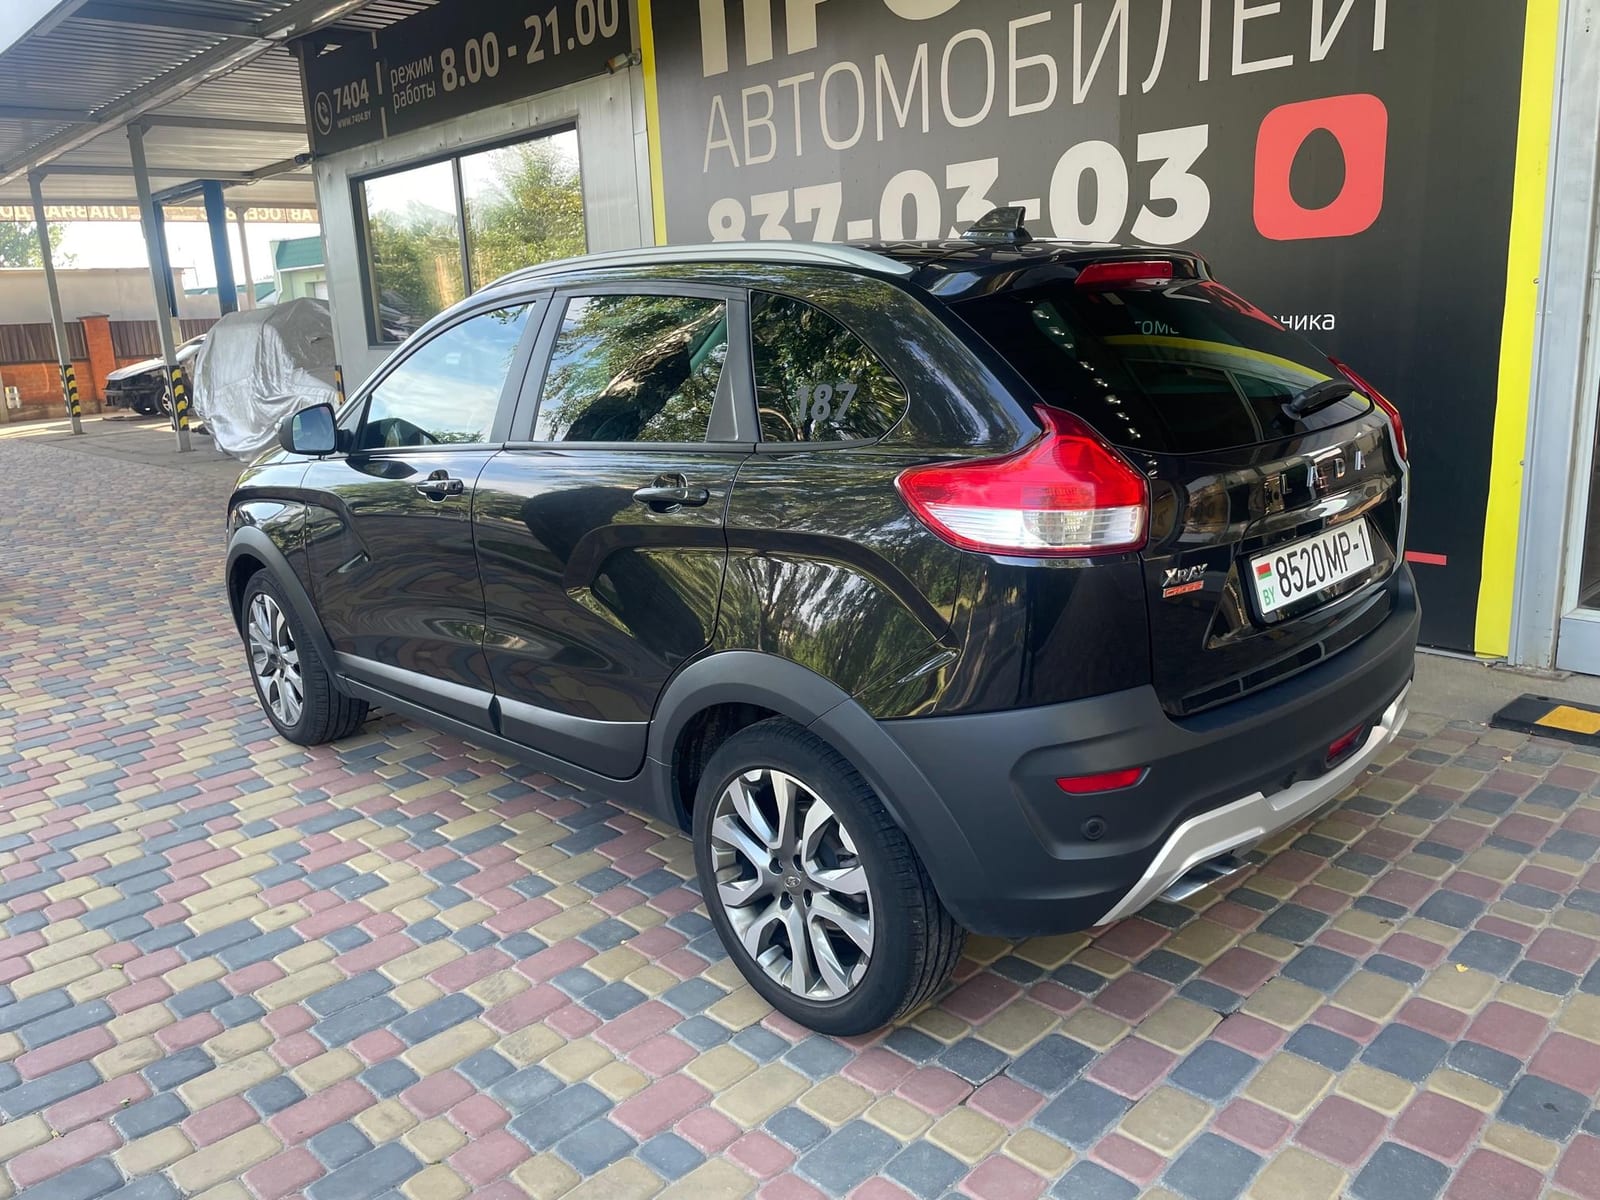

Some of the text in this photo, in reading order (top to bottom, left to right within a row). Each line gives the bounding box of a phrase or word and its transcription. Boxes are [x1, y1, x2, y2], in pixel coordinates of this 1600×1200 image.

[440, 32, 499, 92] 8.00
[523, 0, 620, 65] 21.00
[390, 55, 434, 92] режим
[333, 78, 369, 114] 7404
[393, 81, 436, 114] работы
[707, 124, 1211, 245] 837-03-03
[1273, 313, 1335, 331] чика
[796, 383, 858, 422] 187
[1281, 450, 1367, 495] LADA
[1275, 524, 1370, 598] 8520MP-1
[1263, 586, 1276, 608] BY
